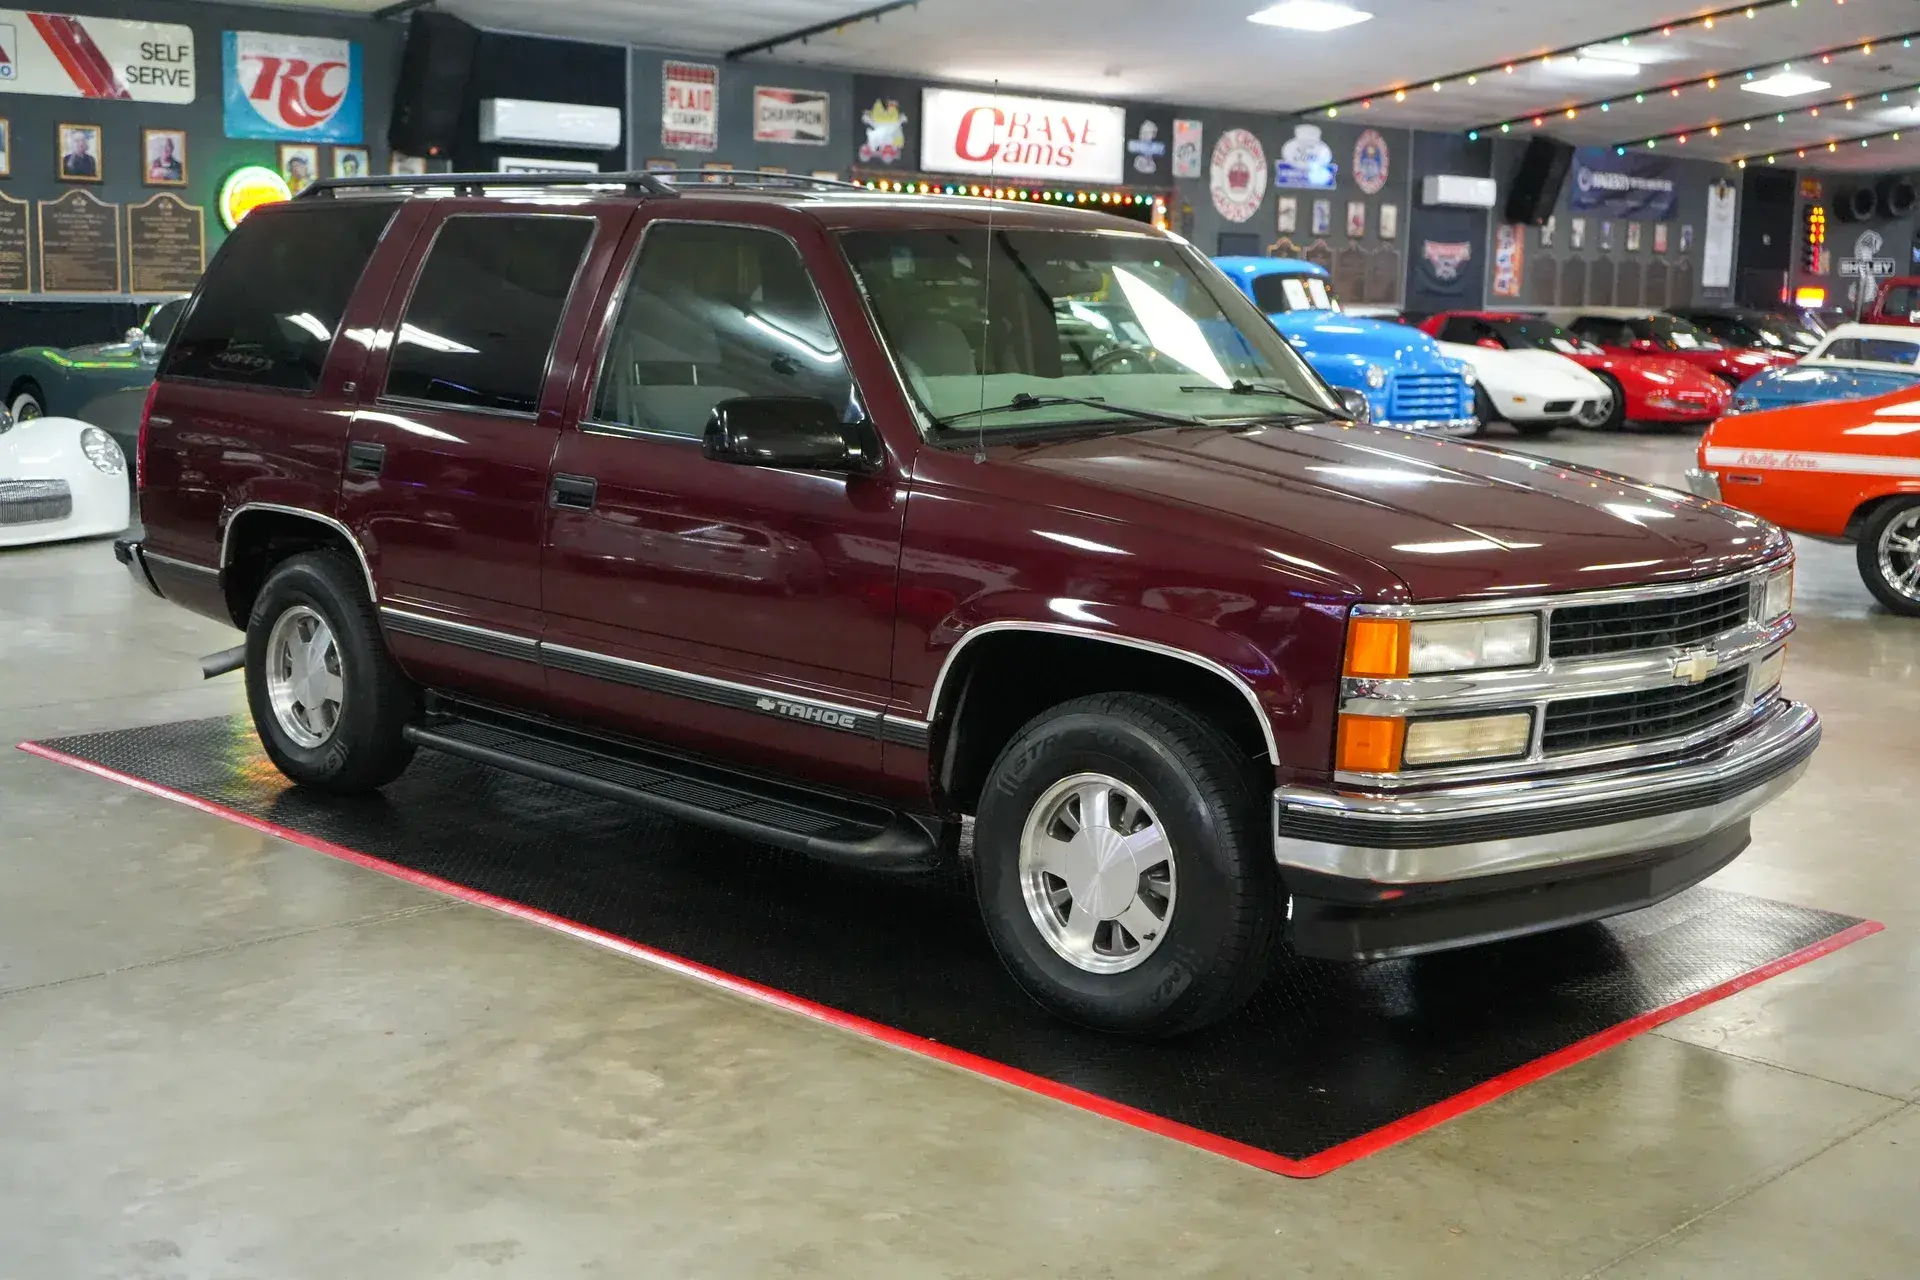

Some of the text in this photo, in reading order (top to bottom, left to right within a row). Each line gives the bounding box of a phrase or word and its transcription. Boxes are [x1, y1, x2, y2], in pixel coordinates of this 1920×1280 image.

[140, 42, 190, 63] SELF
[125, 65, 191, 88] SERVE
[241, 55, 347, 129] RC
[667, 86, 712, 112] PLAID
[760, 105, 823, 125] CHAMPION
[954, 106, 1097, 163] CRANE
[777, 700, 856, 728] TAHOE
